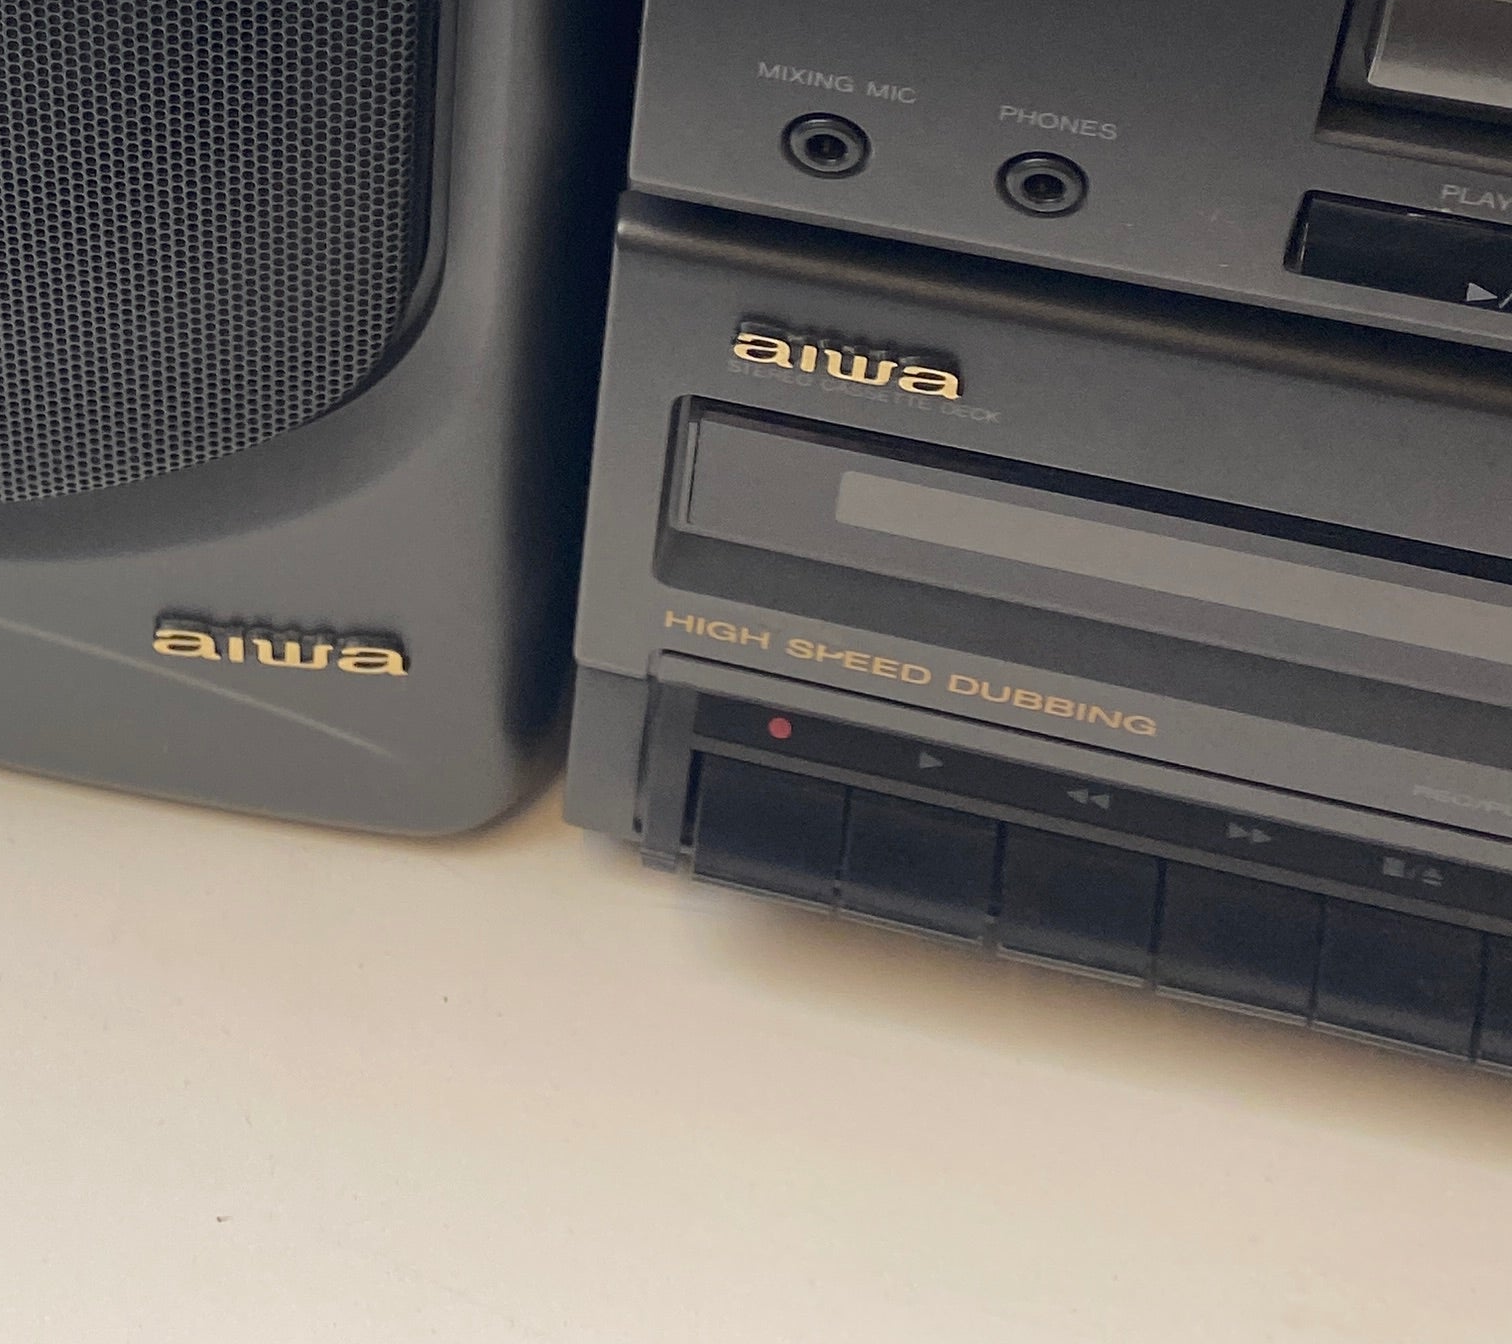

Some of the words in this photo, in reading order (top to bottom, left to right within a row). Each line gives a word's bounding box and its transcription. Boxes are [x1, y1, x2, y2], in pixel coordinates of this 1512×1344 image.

[758, 61, 855, 93] MIXING
[867, 81, 917, 105] MIC
[1000, 105, 1118, 141] PHONES
[727, 359, 813, 388] STEREO
[940, 401, 1001, 424] DECK
[733, 329, 961, 400] aiwa
[152, 624, 409, 676] aiwa
[664, 610, 770, 650] HIGH
[786, 637, 932, 686] SPEED
[947, 673, 1158, 736] DUBBING
